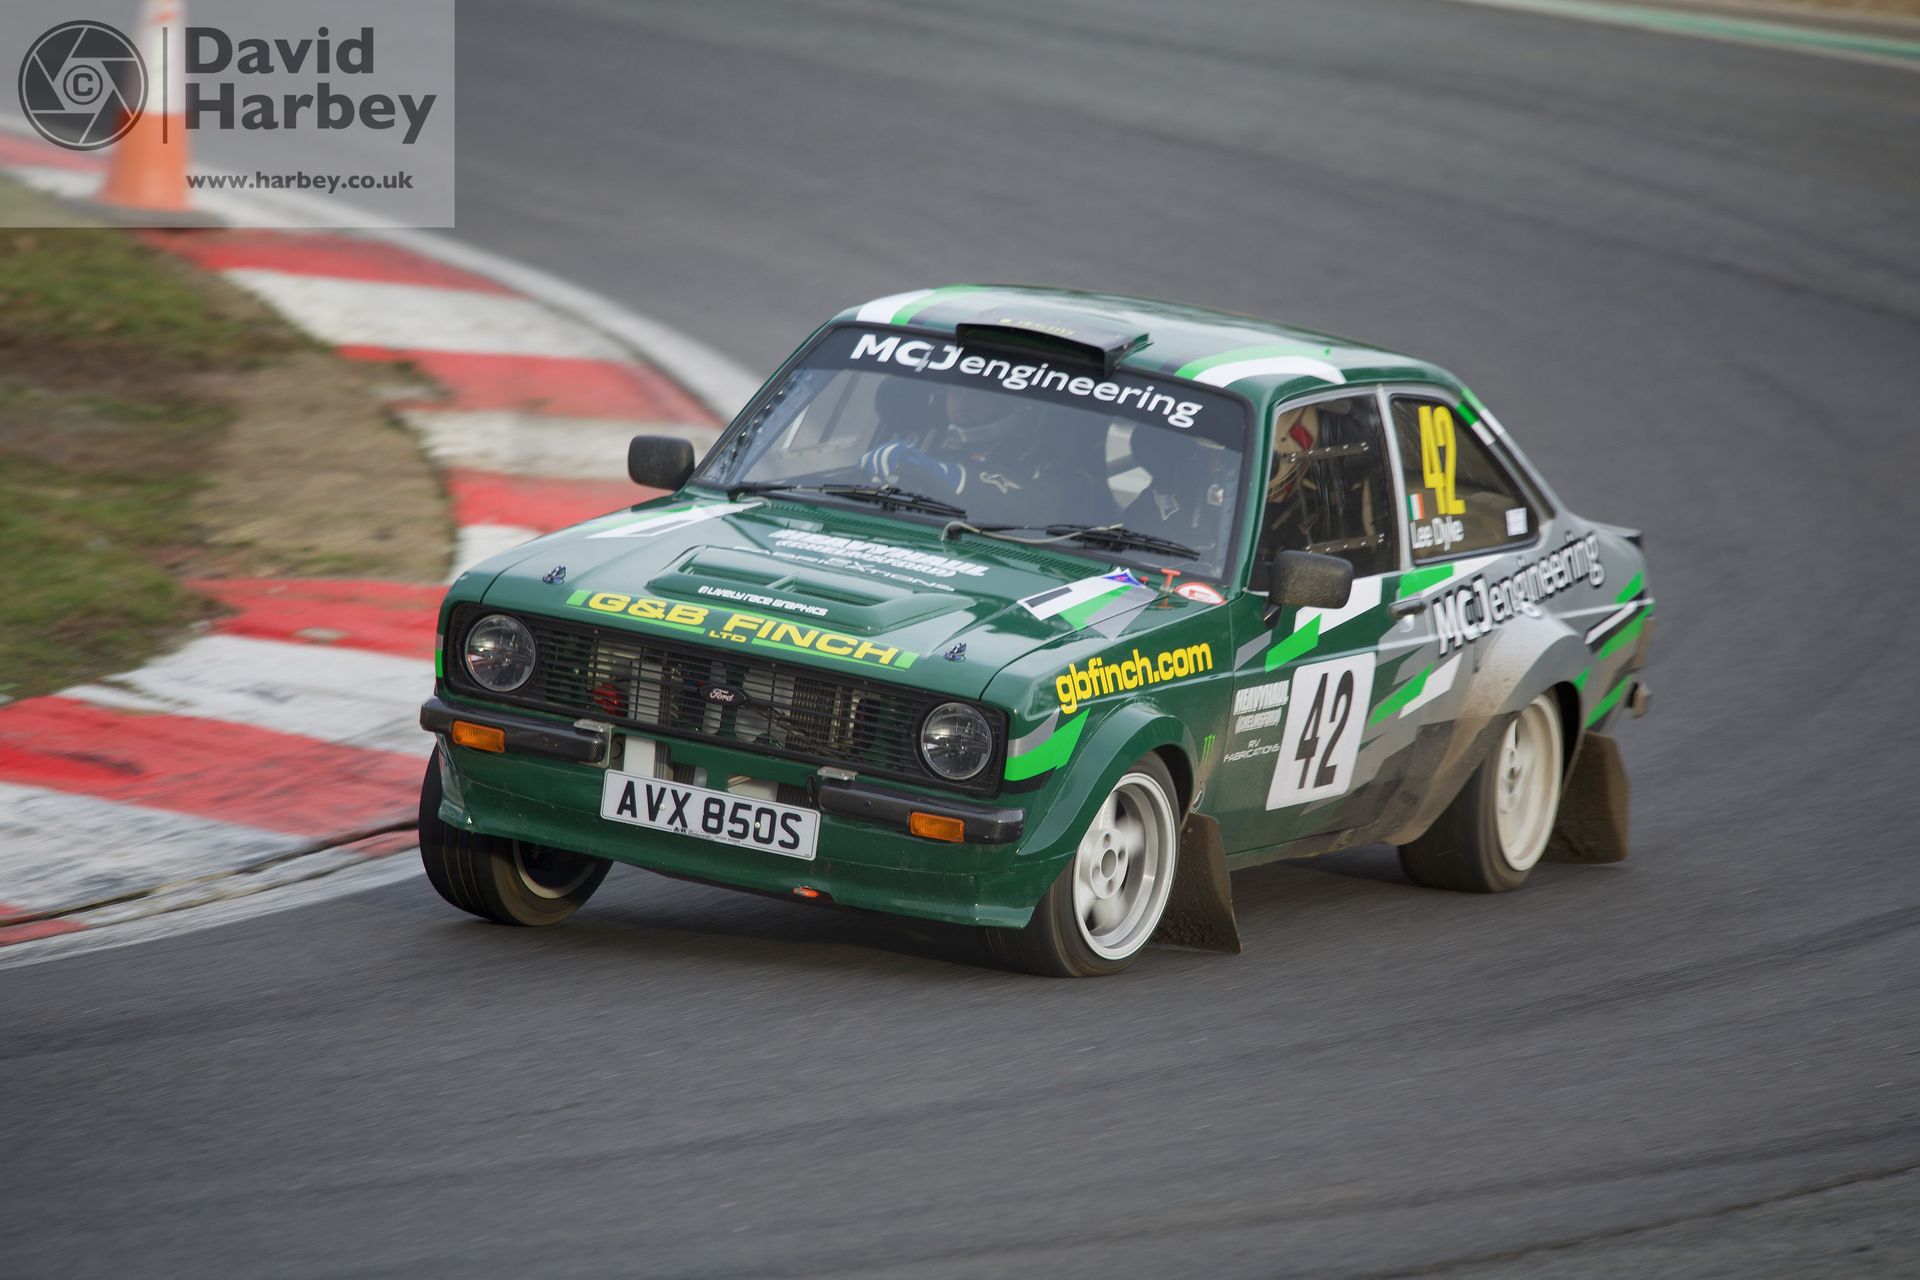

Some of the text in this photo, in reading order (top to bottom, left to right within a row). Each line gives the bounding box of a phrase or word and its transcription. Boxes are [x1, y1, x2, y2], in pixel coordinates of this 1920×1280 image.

[1418, 405, 1466, 515] 42
[1410, 522, 1434, 549] Lee
[587, 591, 899, 665] G&B FINCH
[708, 630, 748, 643] LTD
[709, 688, 735, 702] Ford
[1056, 642, 1213, 715] gbfinch.com
[1223, 742, 1281, 764] FABRICATIONS
[1295, 669, 1354, 790] 42
[616, 780, 802, 850] AVX 850S
